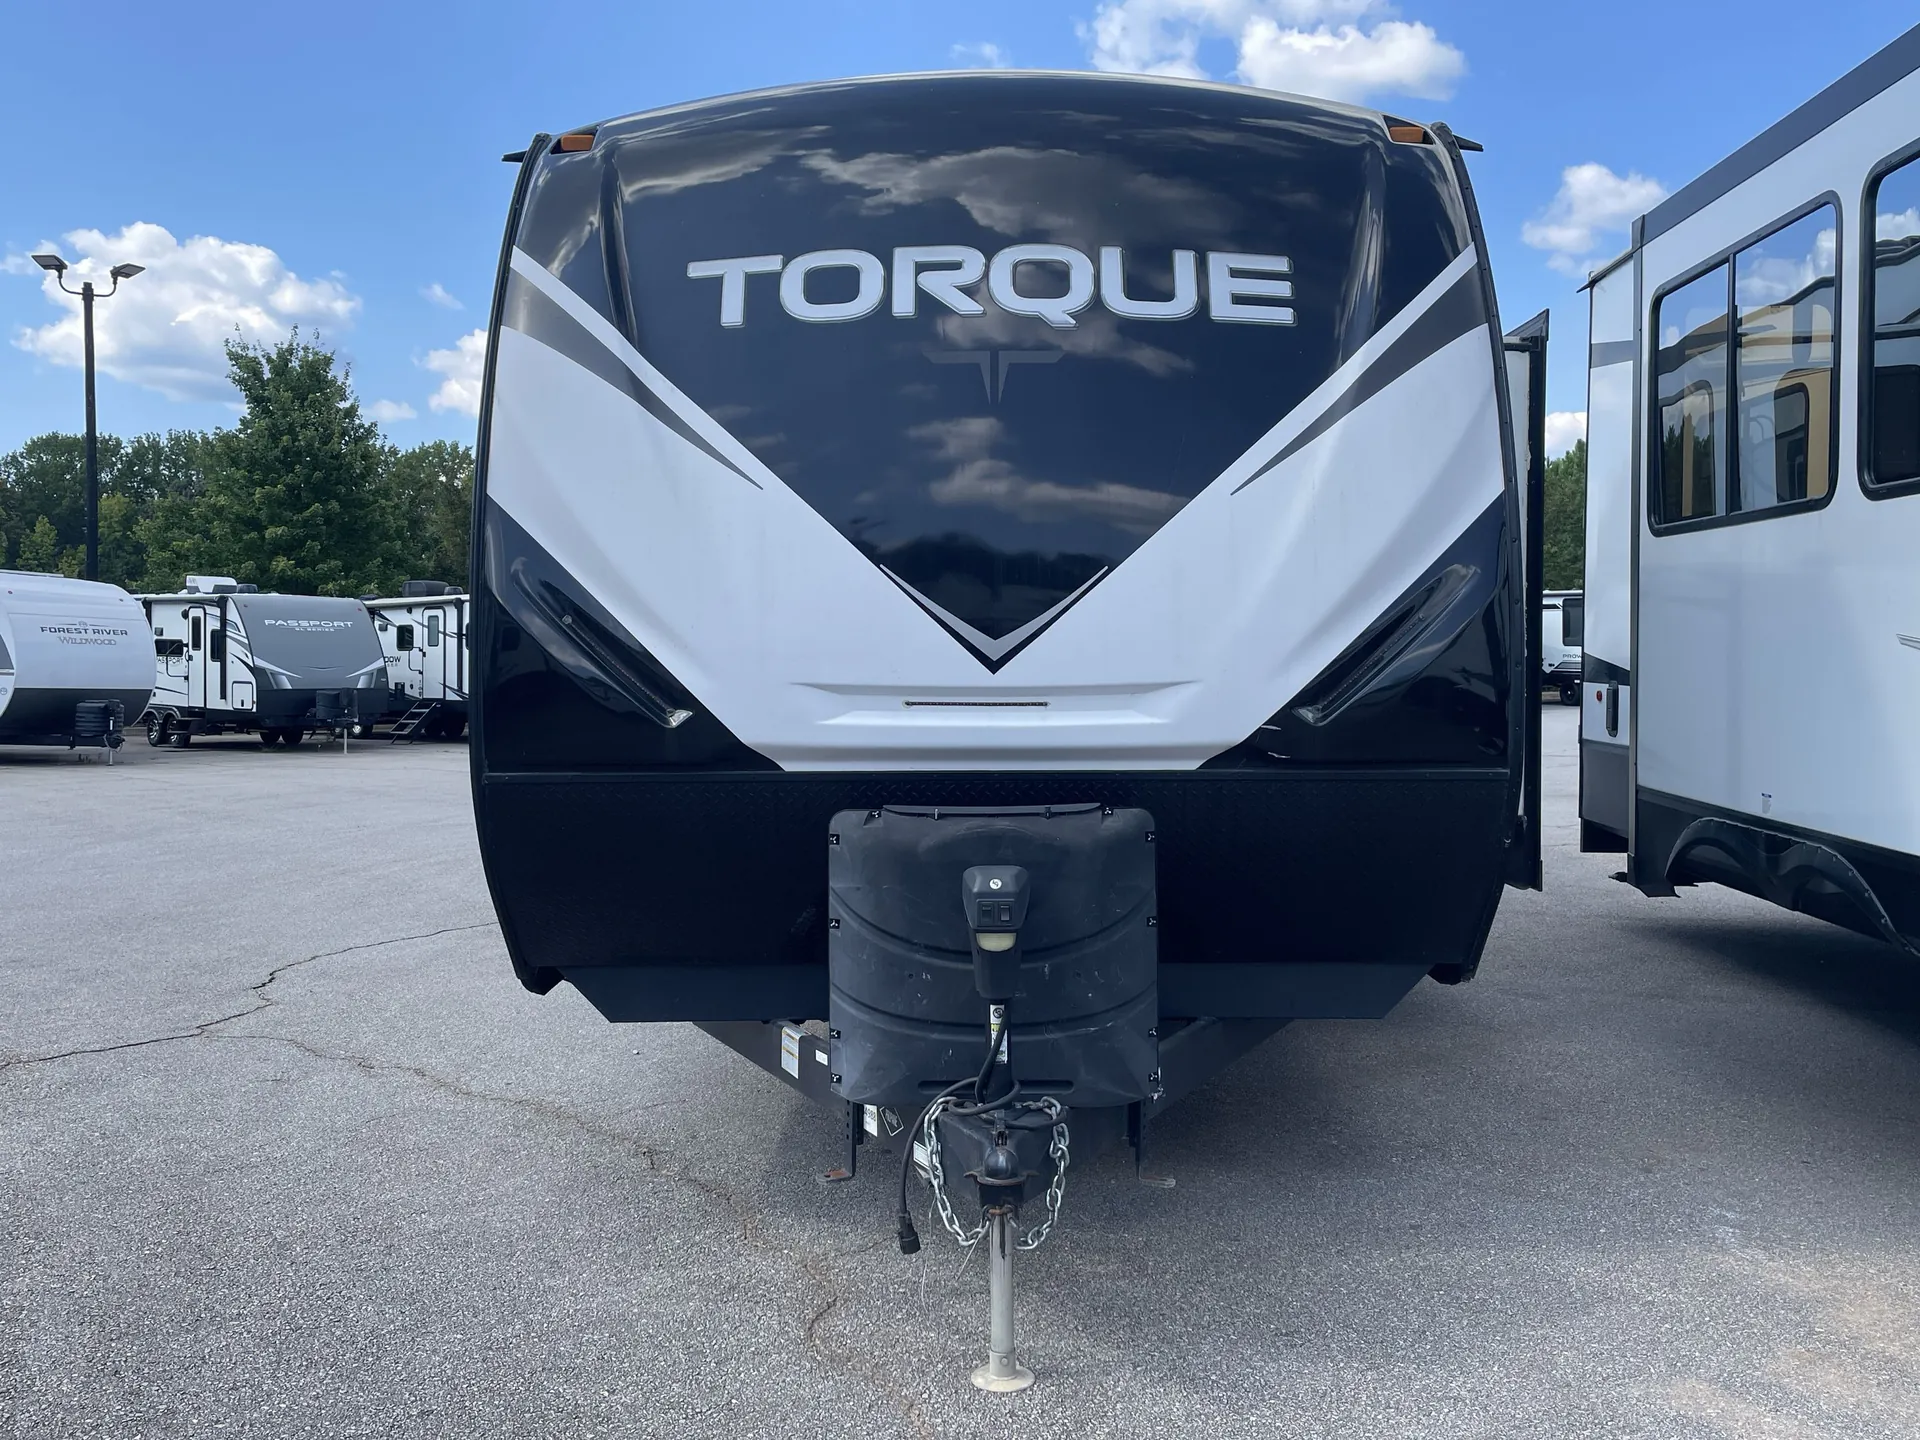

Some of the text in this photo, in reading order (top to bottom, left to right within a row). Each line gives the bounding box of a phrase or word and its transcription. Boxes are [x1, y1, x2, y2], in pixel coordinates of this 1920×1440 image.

[687, 243, 1297, 330] TORQUE
[264, 619, 354, 628] PASSPORT
[40, 626, 128, 636] FOREST RIVER
